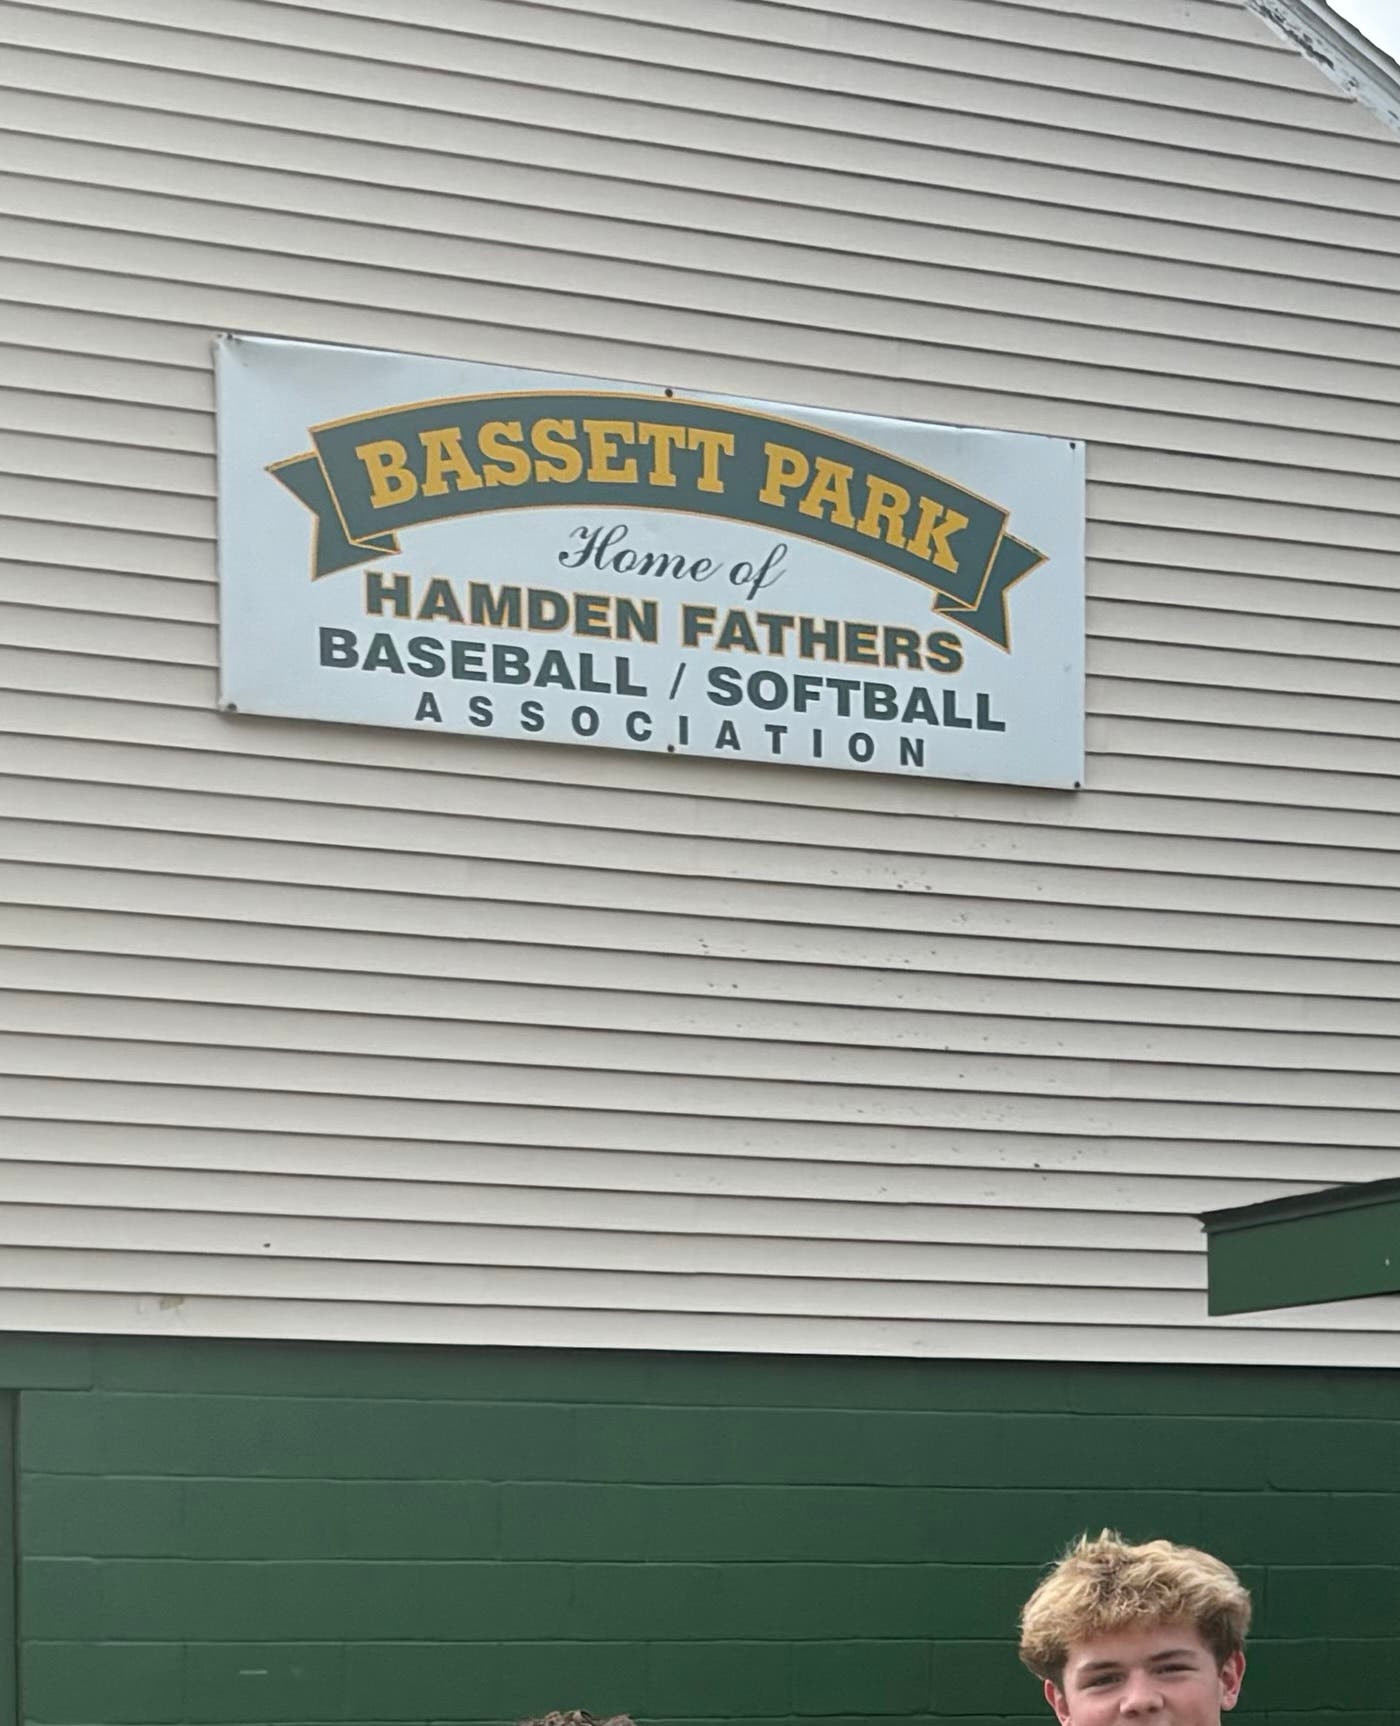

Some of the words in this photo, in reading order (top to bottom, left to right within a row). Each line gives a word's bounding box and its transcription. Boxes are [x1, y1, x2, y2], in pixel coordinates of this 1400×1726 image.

[354, 418, 735, 509] BASSETT
[759, 442, 969, 573] PARK
[557, 525, 724, 583] Home
[728, 543, 788, 601] of
[364, 570, 659, 645] HAMDEN
[681, 603, 965, 674] FATHERS
[319, 626, 648, 698] BASEBALL
[669, 662, 687, 701] /
[706, 666, 1006, 733] SOFTBALL
[414, 691, 925, 768] ASSOCIATION
